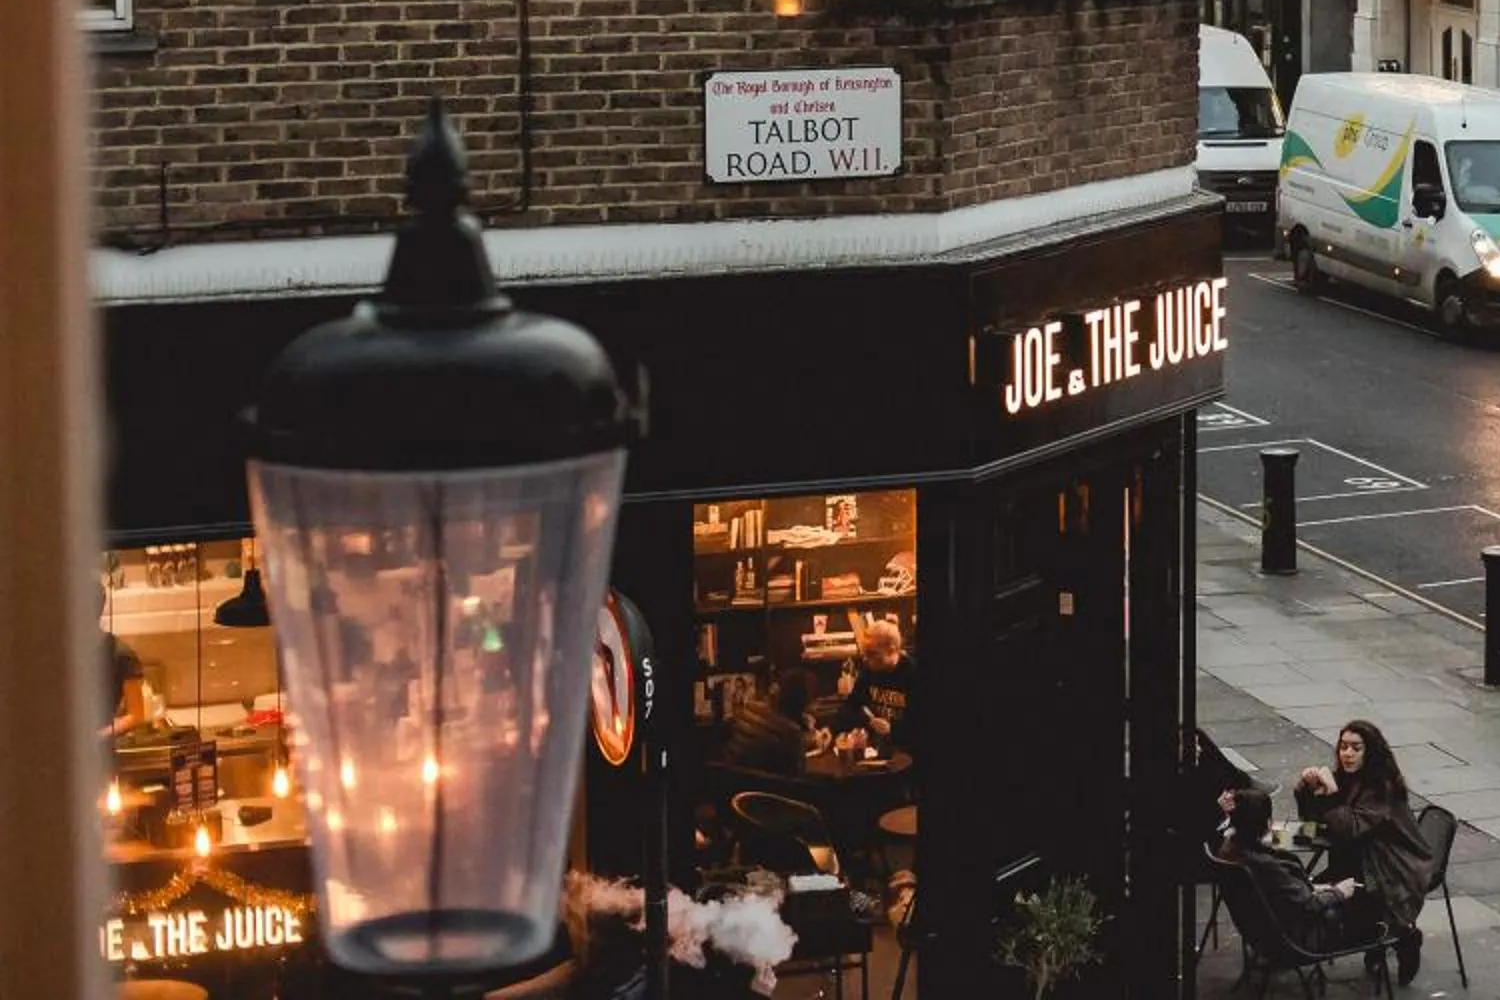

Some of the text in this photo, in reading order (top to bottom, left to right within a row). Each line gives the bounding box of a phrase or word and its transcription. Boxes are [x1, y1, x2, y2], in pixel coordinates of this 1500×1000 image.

[736, 80, 767, 97] Royal
[772, 79, 815, 97] Borough
[820, 78, 831, 91] of
[793, 100, 836, 113] Chelsea
[748, 117, 859, 145] TALBOT
[1005, 277, 1228, 414] JOE & THE JUICE
[147, 910, 209, 957] THE
[215, 904, 303, 951] JUICE
